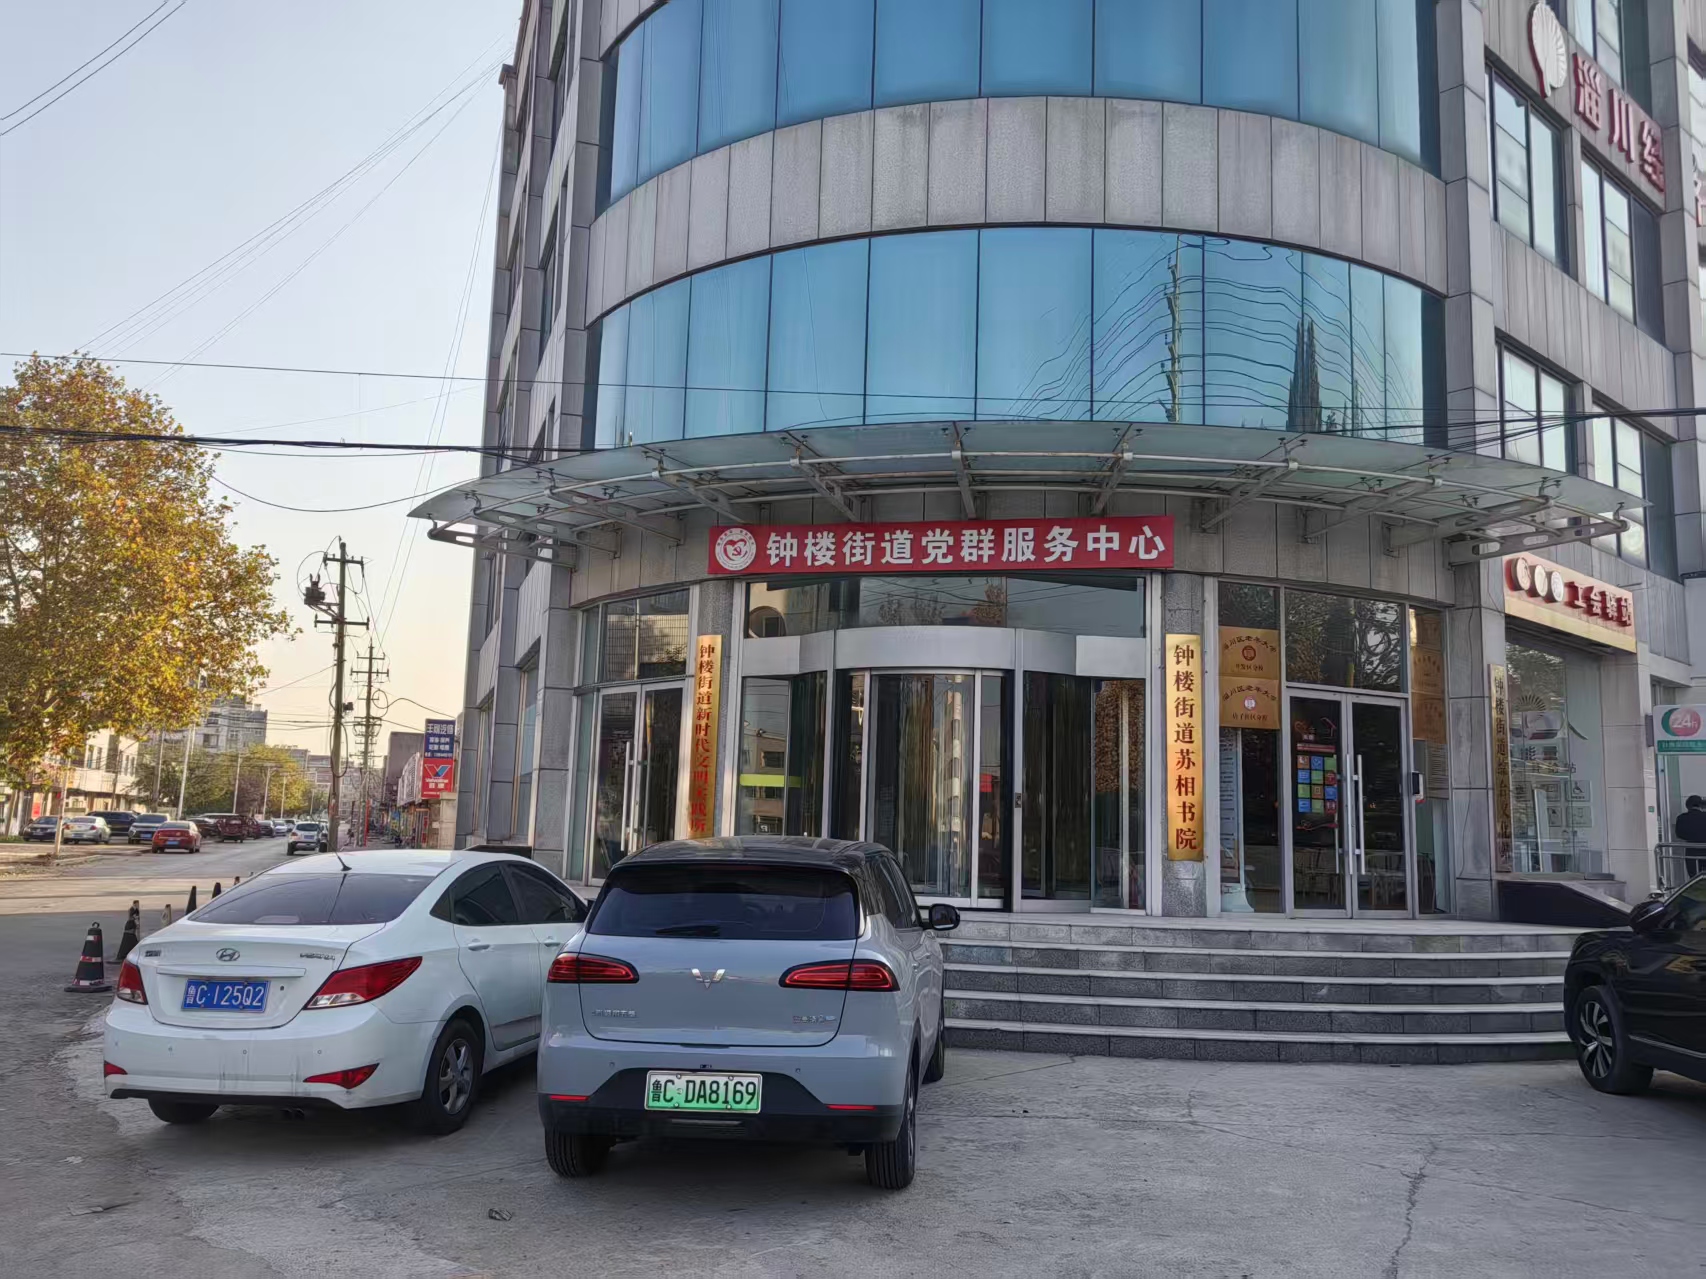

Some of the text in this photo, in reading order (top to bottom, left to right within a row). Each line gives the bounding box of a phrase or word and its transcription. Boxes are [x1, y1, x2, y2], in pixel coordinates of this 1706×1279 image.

[766, 524, 1166, 567] 钟楼街道党群服务中心
[689, 644, 716, 833] 钟楼街道新时代文明实践所
[1173, 643, 1199, 851] 钟楼街道苏相书院
[186, 984, 265, 1007] 鲁C·125Q2
